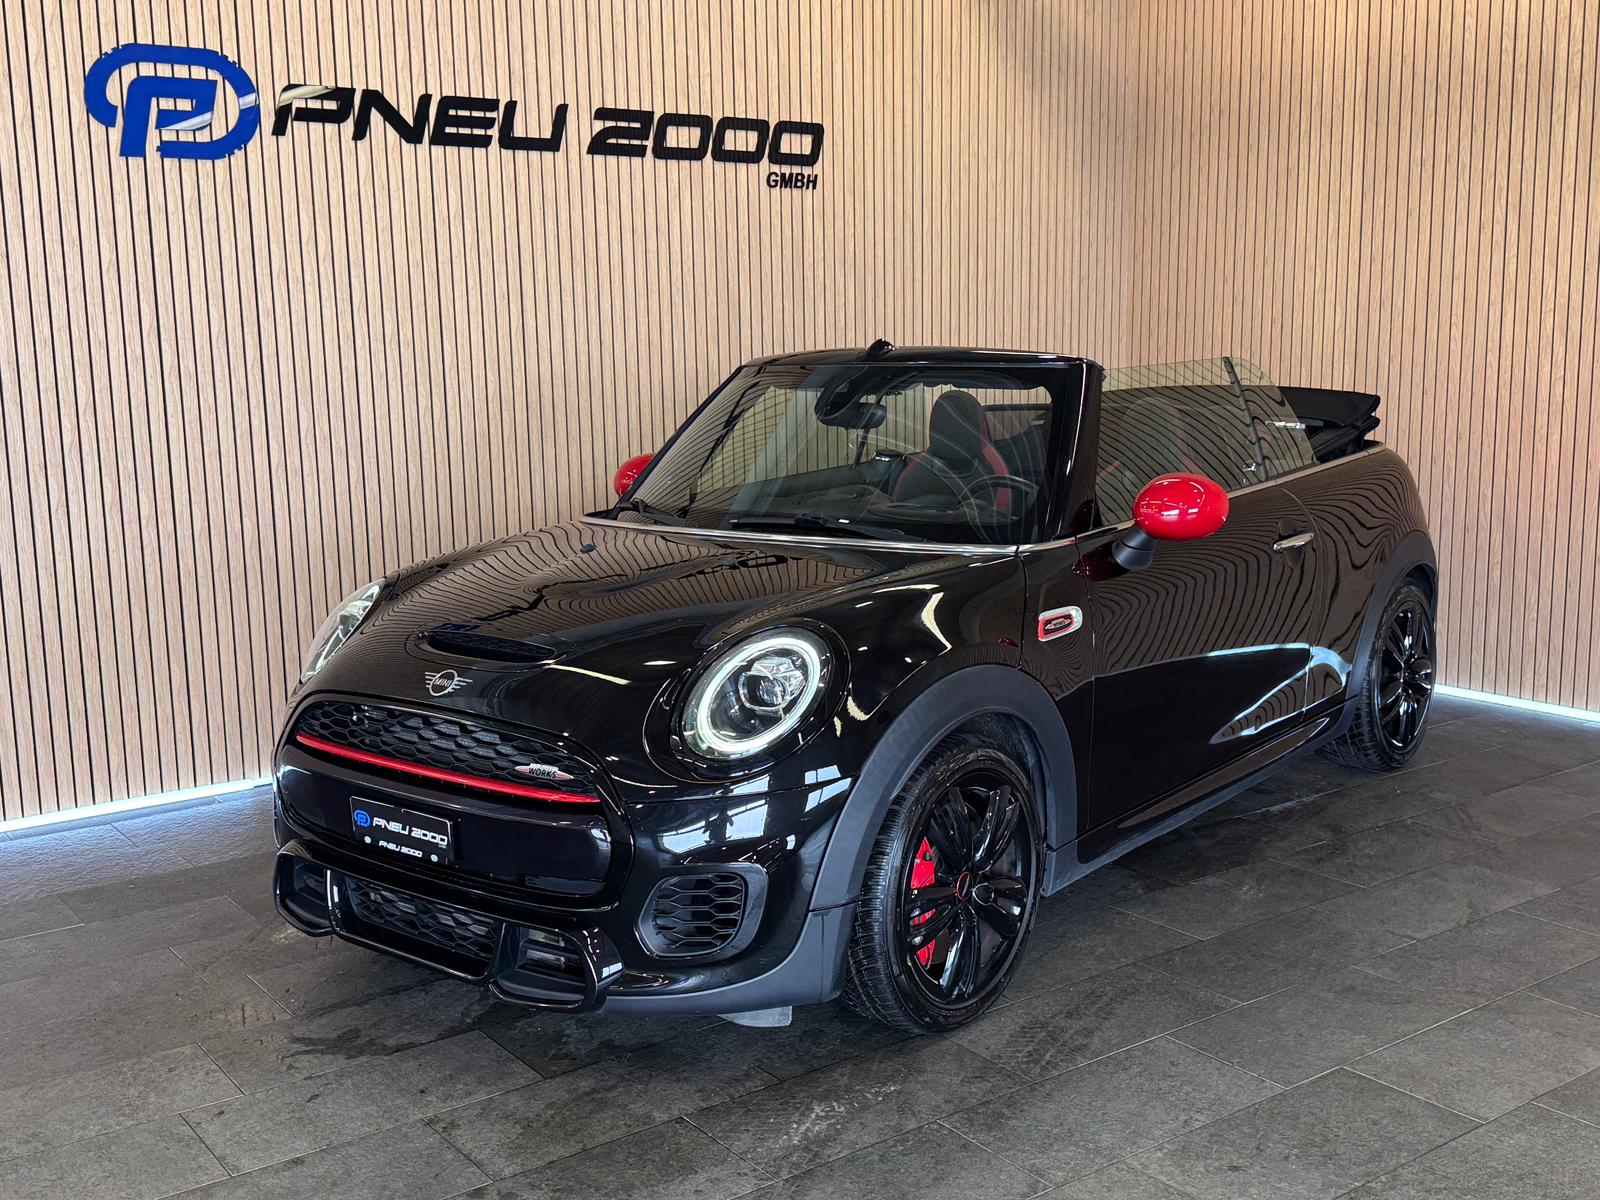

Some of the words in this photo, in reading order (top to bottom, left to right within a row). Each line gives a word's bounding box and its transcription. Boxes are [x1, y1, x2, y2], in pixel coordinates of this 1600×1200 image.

[271, 83, 569, 153] PNEU
[586, 107, 825, 167] 2000
[766, 171, 819, 190] GMBH
[433, 677, 453, 687] MINI
[528, 767, 557, 779] WORKS
[372, 816, 410, 836] PNEU
[411, 826, 448, 846] 2000
[378, 840, 401, 852] PNEU
[400, 846, 423, 858] 2000
